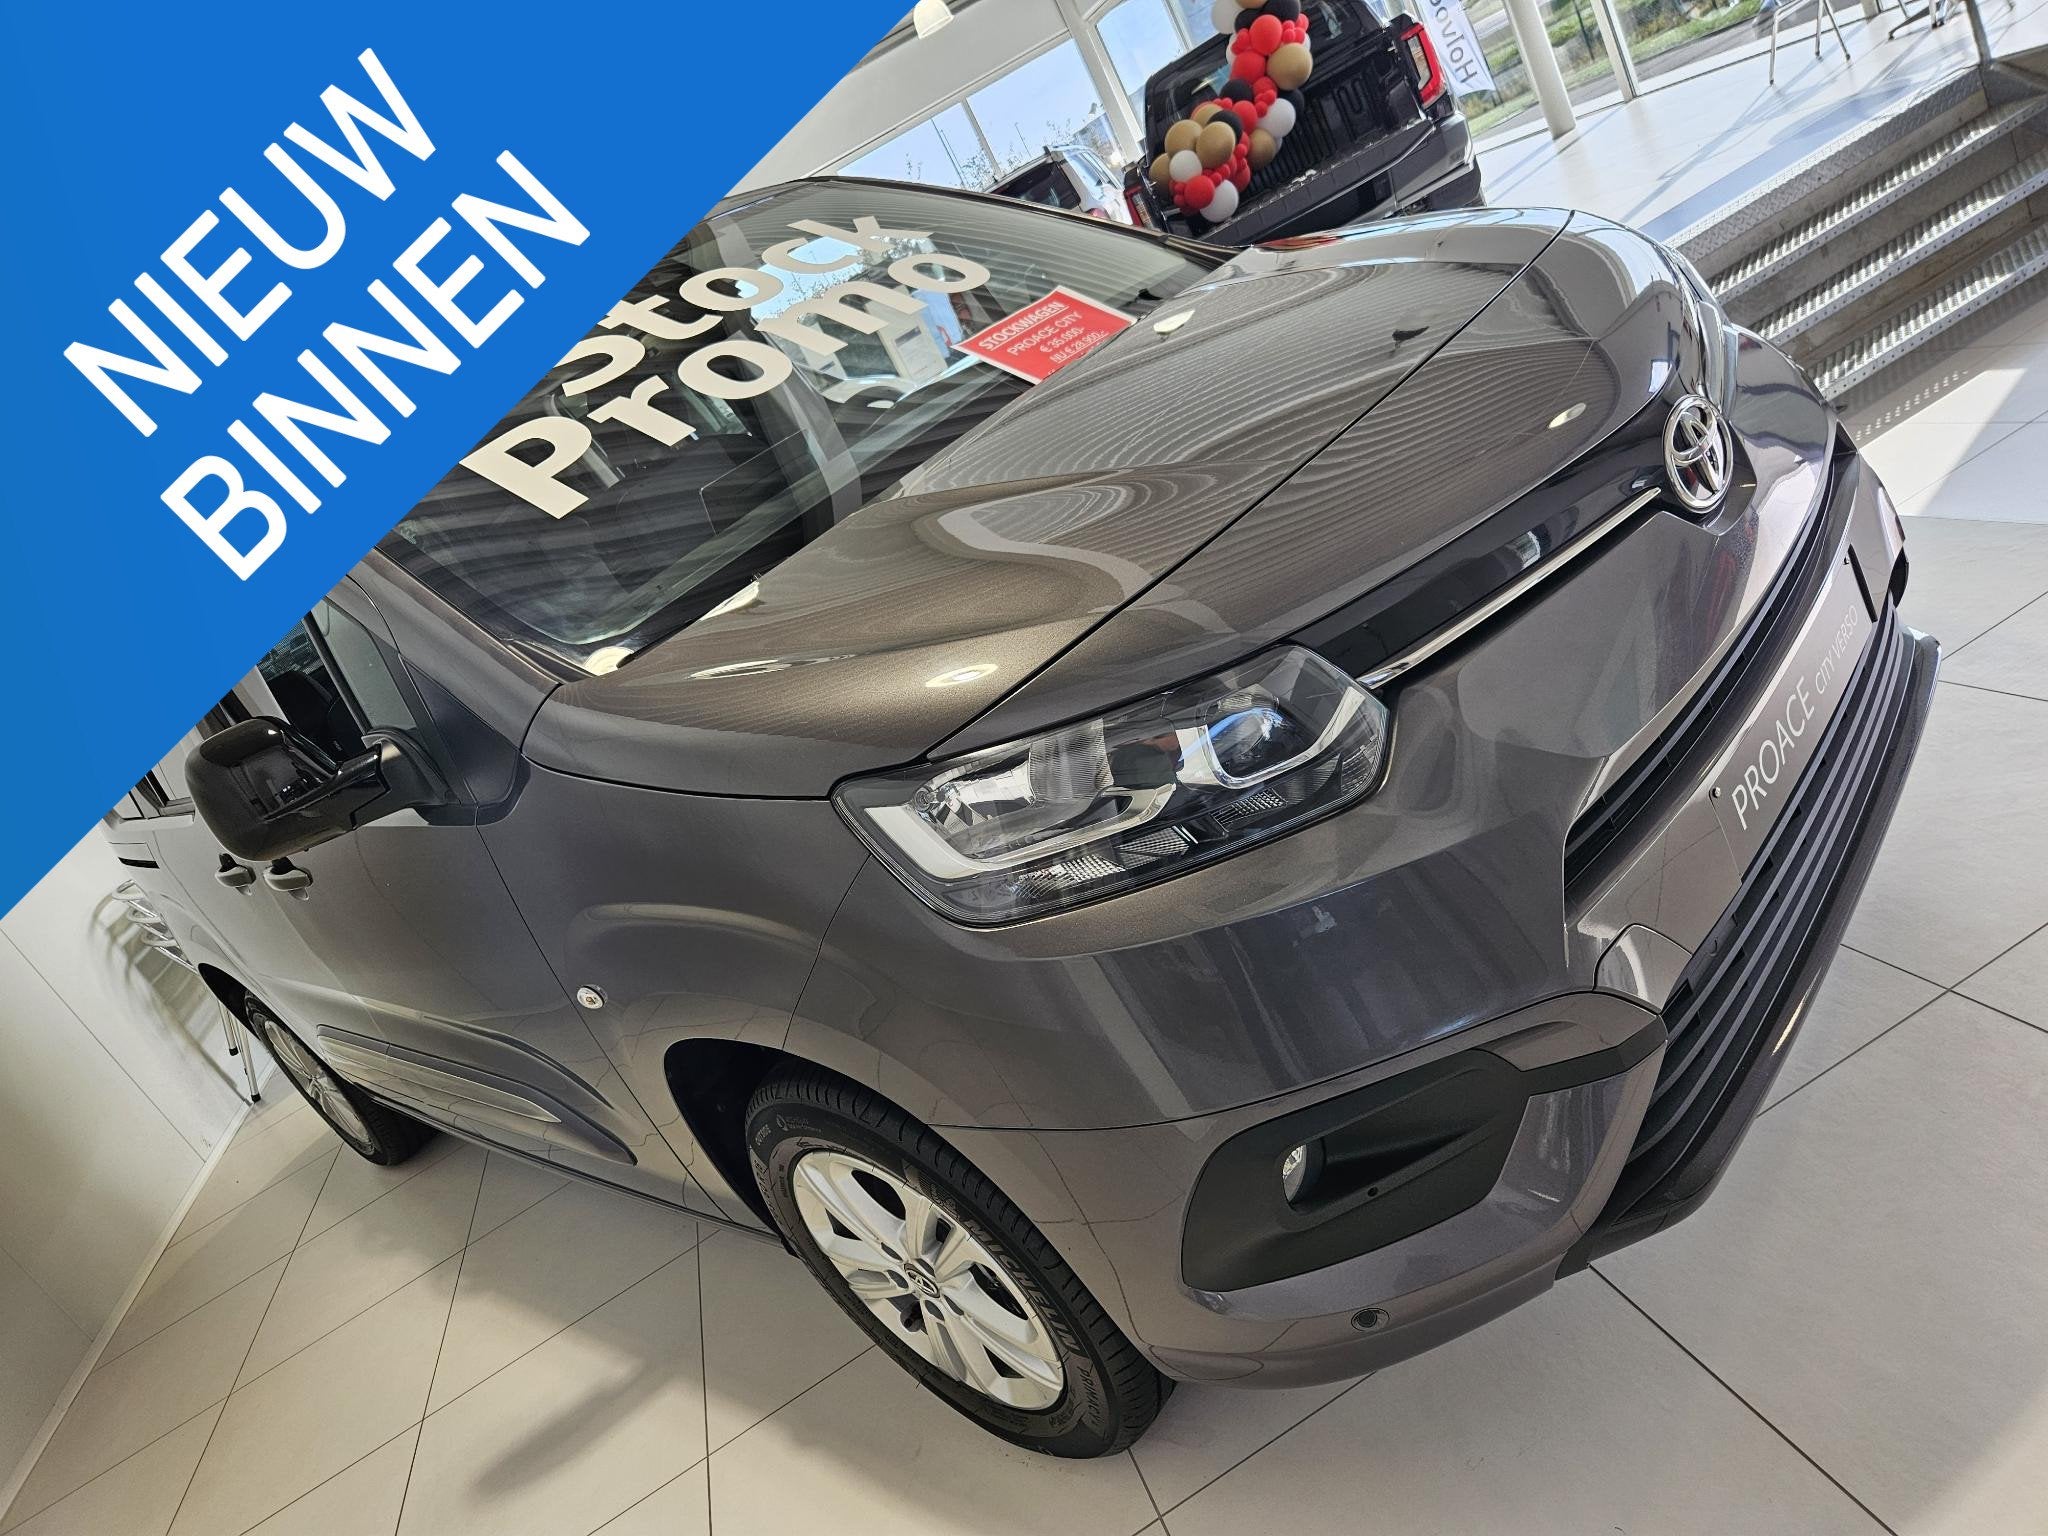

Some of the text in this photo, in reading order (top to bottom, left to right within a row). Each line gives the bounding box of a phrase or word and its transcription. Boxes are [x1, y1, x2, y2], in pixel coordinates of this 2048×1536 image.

[459, 253, 990, 519] Promo
[978, 301, 1066, 350] STOCKWAGEN
[1007, 311, 1083, 356] PROACE CITY
[1731, 605, 1858, 831] PROACE CITY VERSO
[968, 1217, 1090, 1358] MICHELIN
